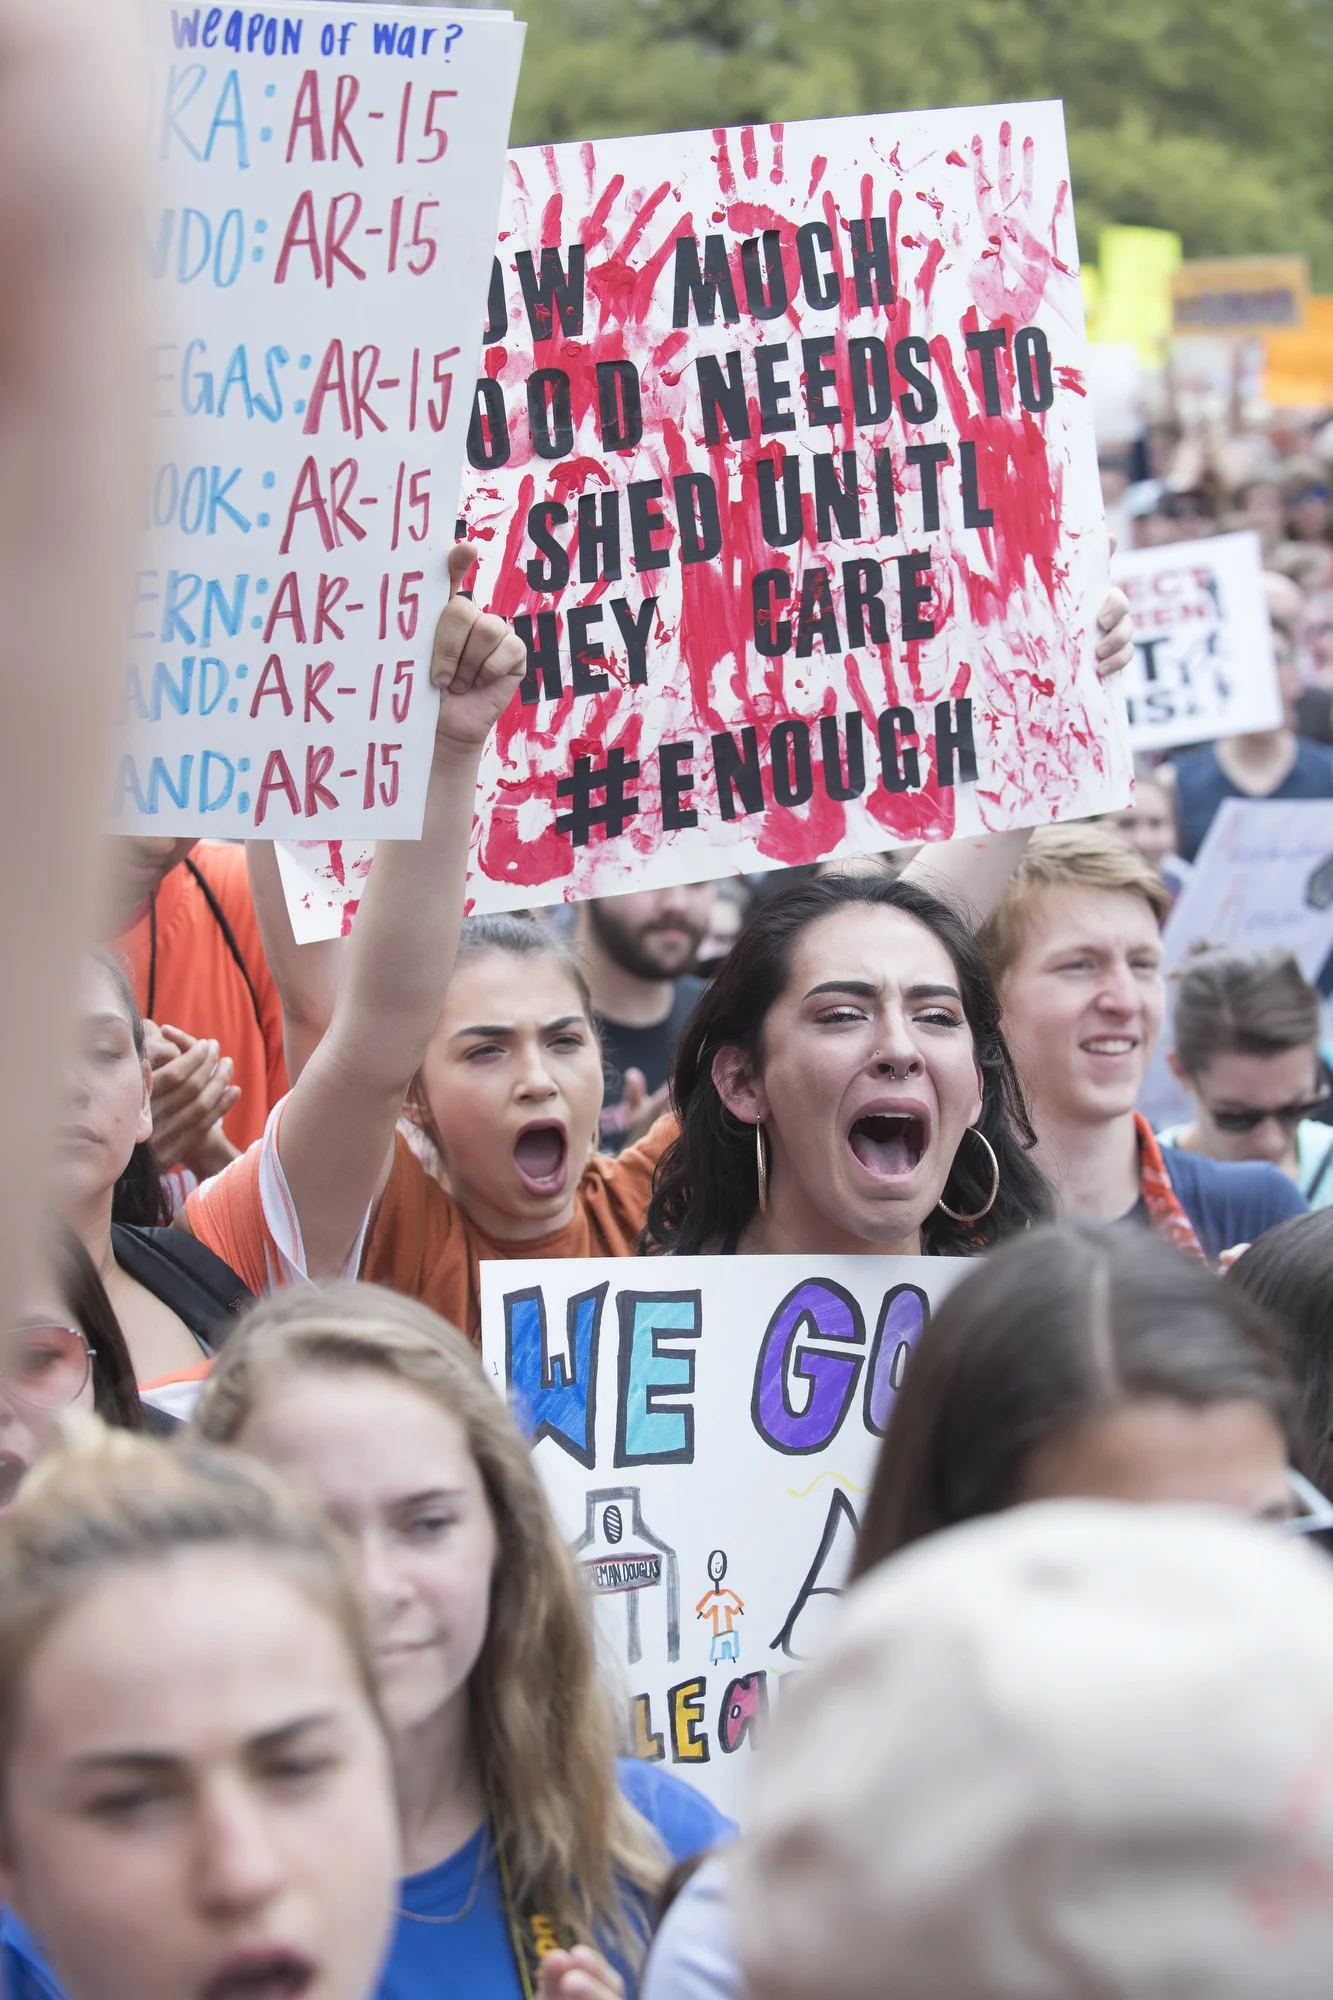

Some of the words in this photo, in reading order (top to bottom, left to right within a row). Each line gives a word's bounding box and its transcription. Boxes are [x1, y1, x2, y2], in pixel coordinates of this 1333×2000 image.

[320, 22, 357, 56] of
[150, 63, 276, 170] RA:
[286, 69, 458, 168] AR-15
[274, 190, 440, 288] AR-15
[672, 217, 894, 329] MUCH
[302, 338, 460, 439] AR-15
[466, 360, 643, 470] OOD
[696, 335, 939, 446] NEEDS
[966, 326, 1055, 417] TO
[150, 462, 275, 535] OOK:
[279, 455, 431, 555] AR-15
[526, 472, 724, 594] SHED
[755, 441, 995, 548] UNITL
[263, 571, 424, 644] AR-15
[503, 596, 661, 705] HEY
[752, 551, 936, 658] CARE
[249, 654, 414, 723] AR-15
[254, 742, 402, 826] AR-15
[555, 697, 979, 848] #ENOUGH
[502, 1280, 702, 1470] WE
[622, 1559, 661, 1582] DOUGLAS
[629, 1668, 792, 1764] LEA
